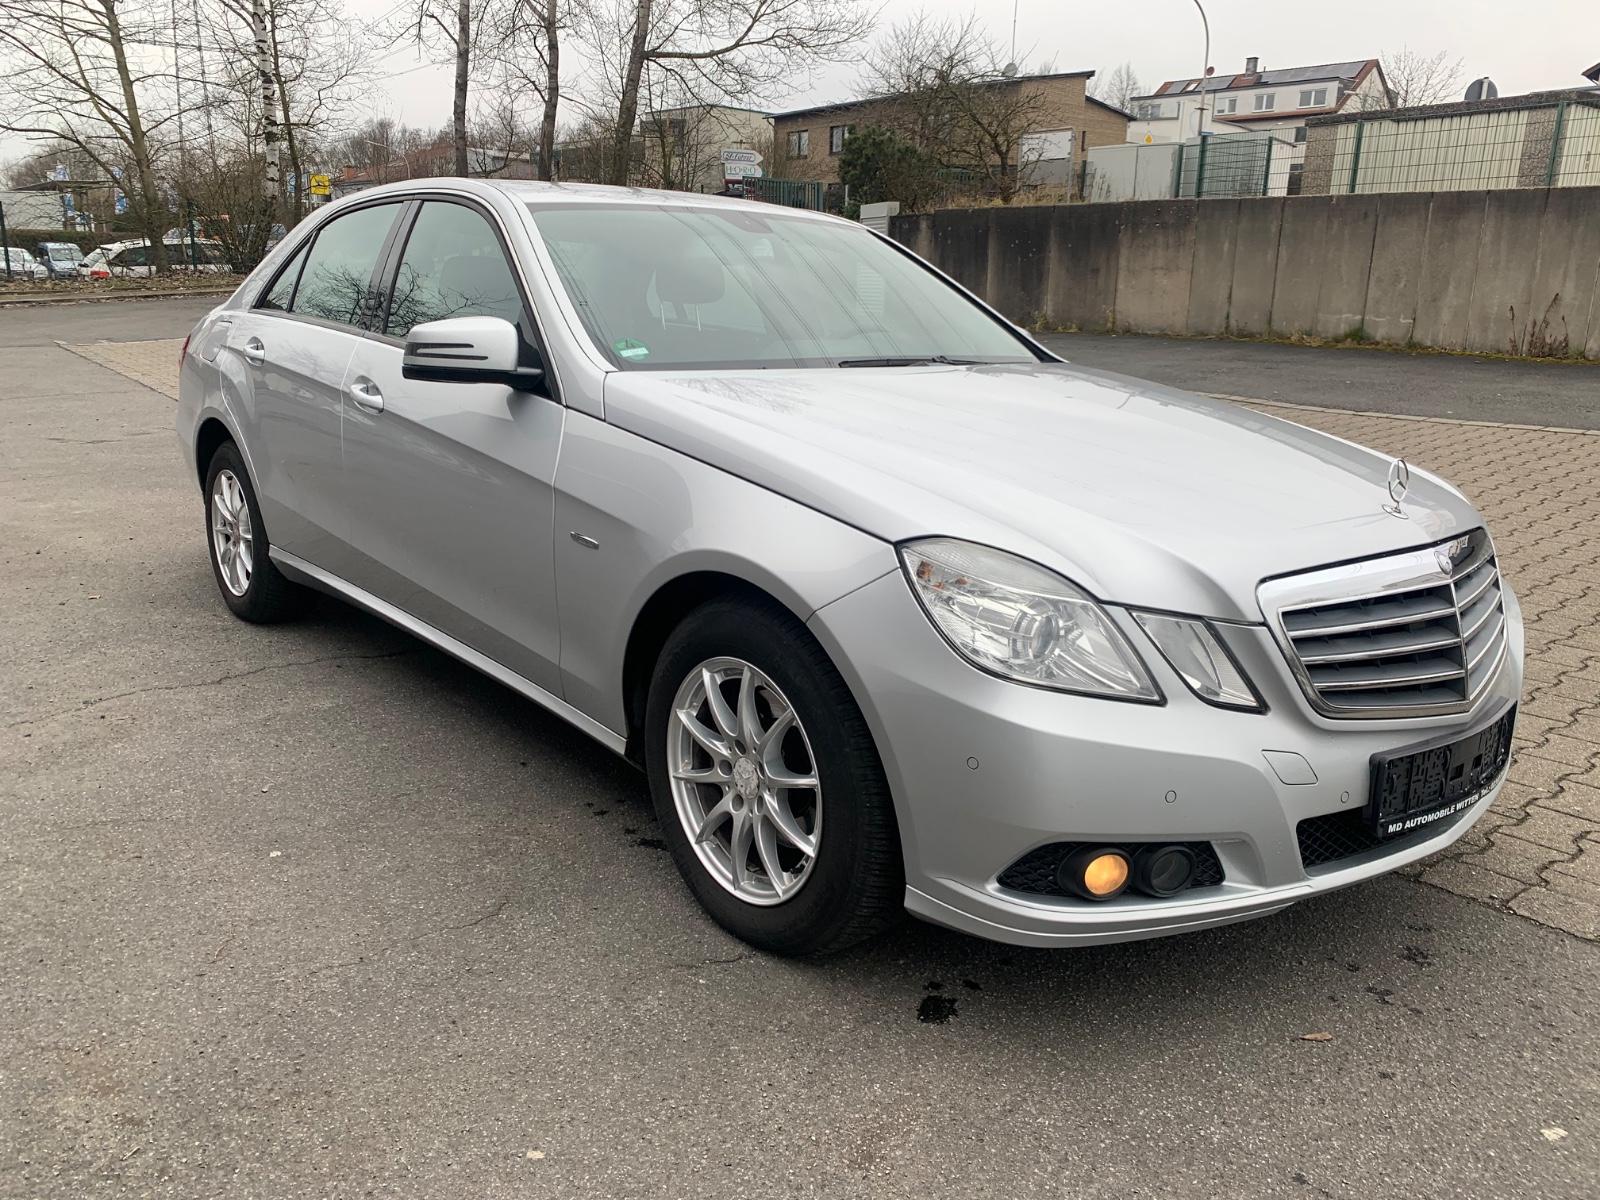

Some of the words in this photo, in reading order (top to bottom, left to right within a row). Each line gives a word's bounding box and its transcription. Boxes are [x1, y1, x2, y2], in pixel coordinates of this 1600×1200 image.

[1387, 822, 1403, 834] MD
[1404, 805, 1456, 829] AUTOMOBILE
[1456, 794, 1479, 811] WITTEN
